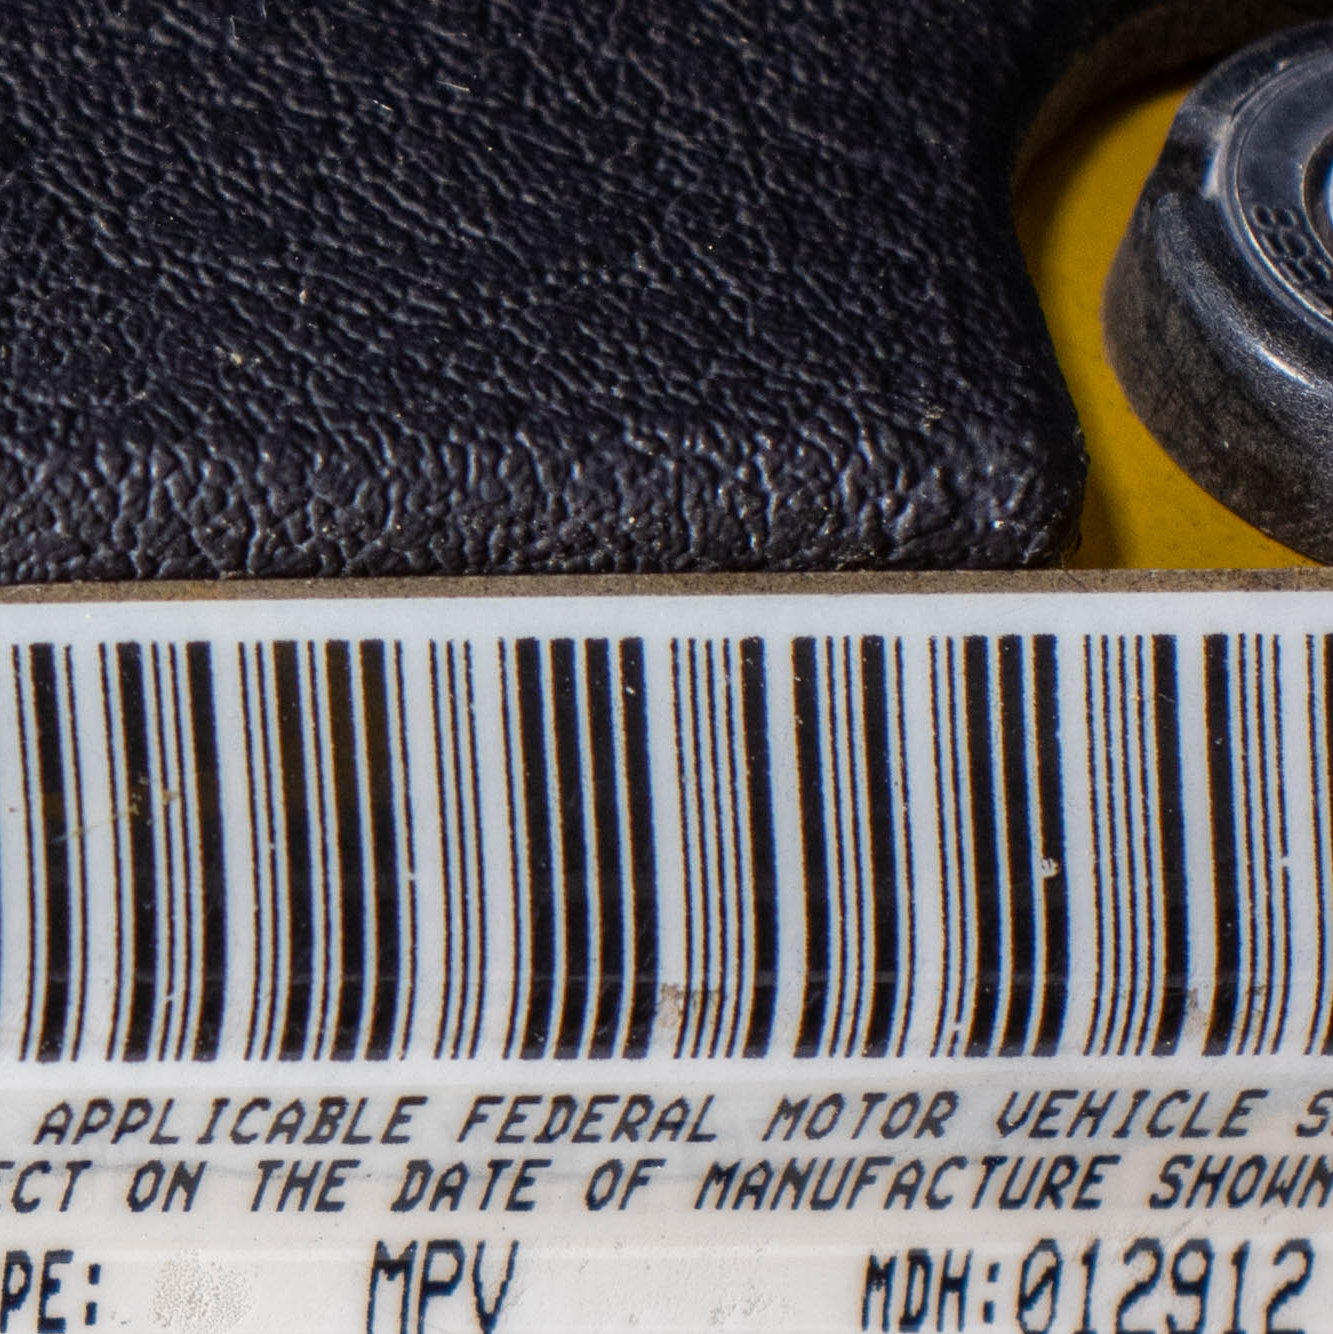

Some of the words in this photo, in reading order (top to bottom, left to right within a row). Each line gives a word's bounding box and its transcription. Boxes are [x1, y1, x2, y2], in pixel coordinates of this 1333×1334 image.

[33, 1095, 429, 1146] APPLICABLE
[456, 1093, 717, 1144] FEDERAL
[761, 1090, 960, 1142] MOTOR
[995, 1088, 1269, 1140] VEHICLE
[1295, 1088, 1333, 1138] S
[126, 1159, 208, 1213] ON
[250, 1158, 361, 1213] THE
[390, 1158, 553, 1213] DATE
[584, 1157, 667, 1212] OF
[694, 1154, 1122, 1211] MANUFACTURE
[1148, 1154, 1333, 1210] SHOWN
